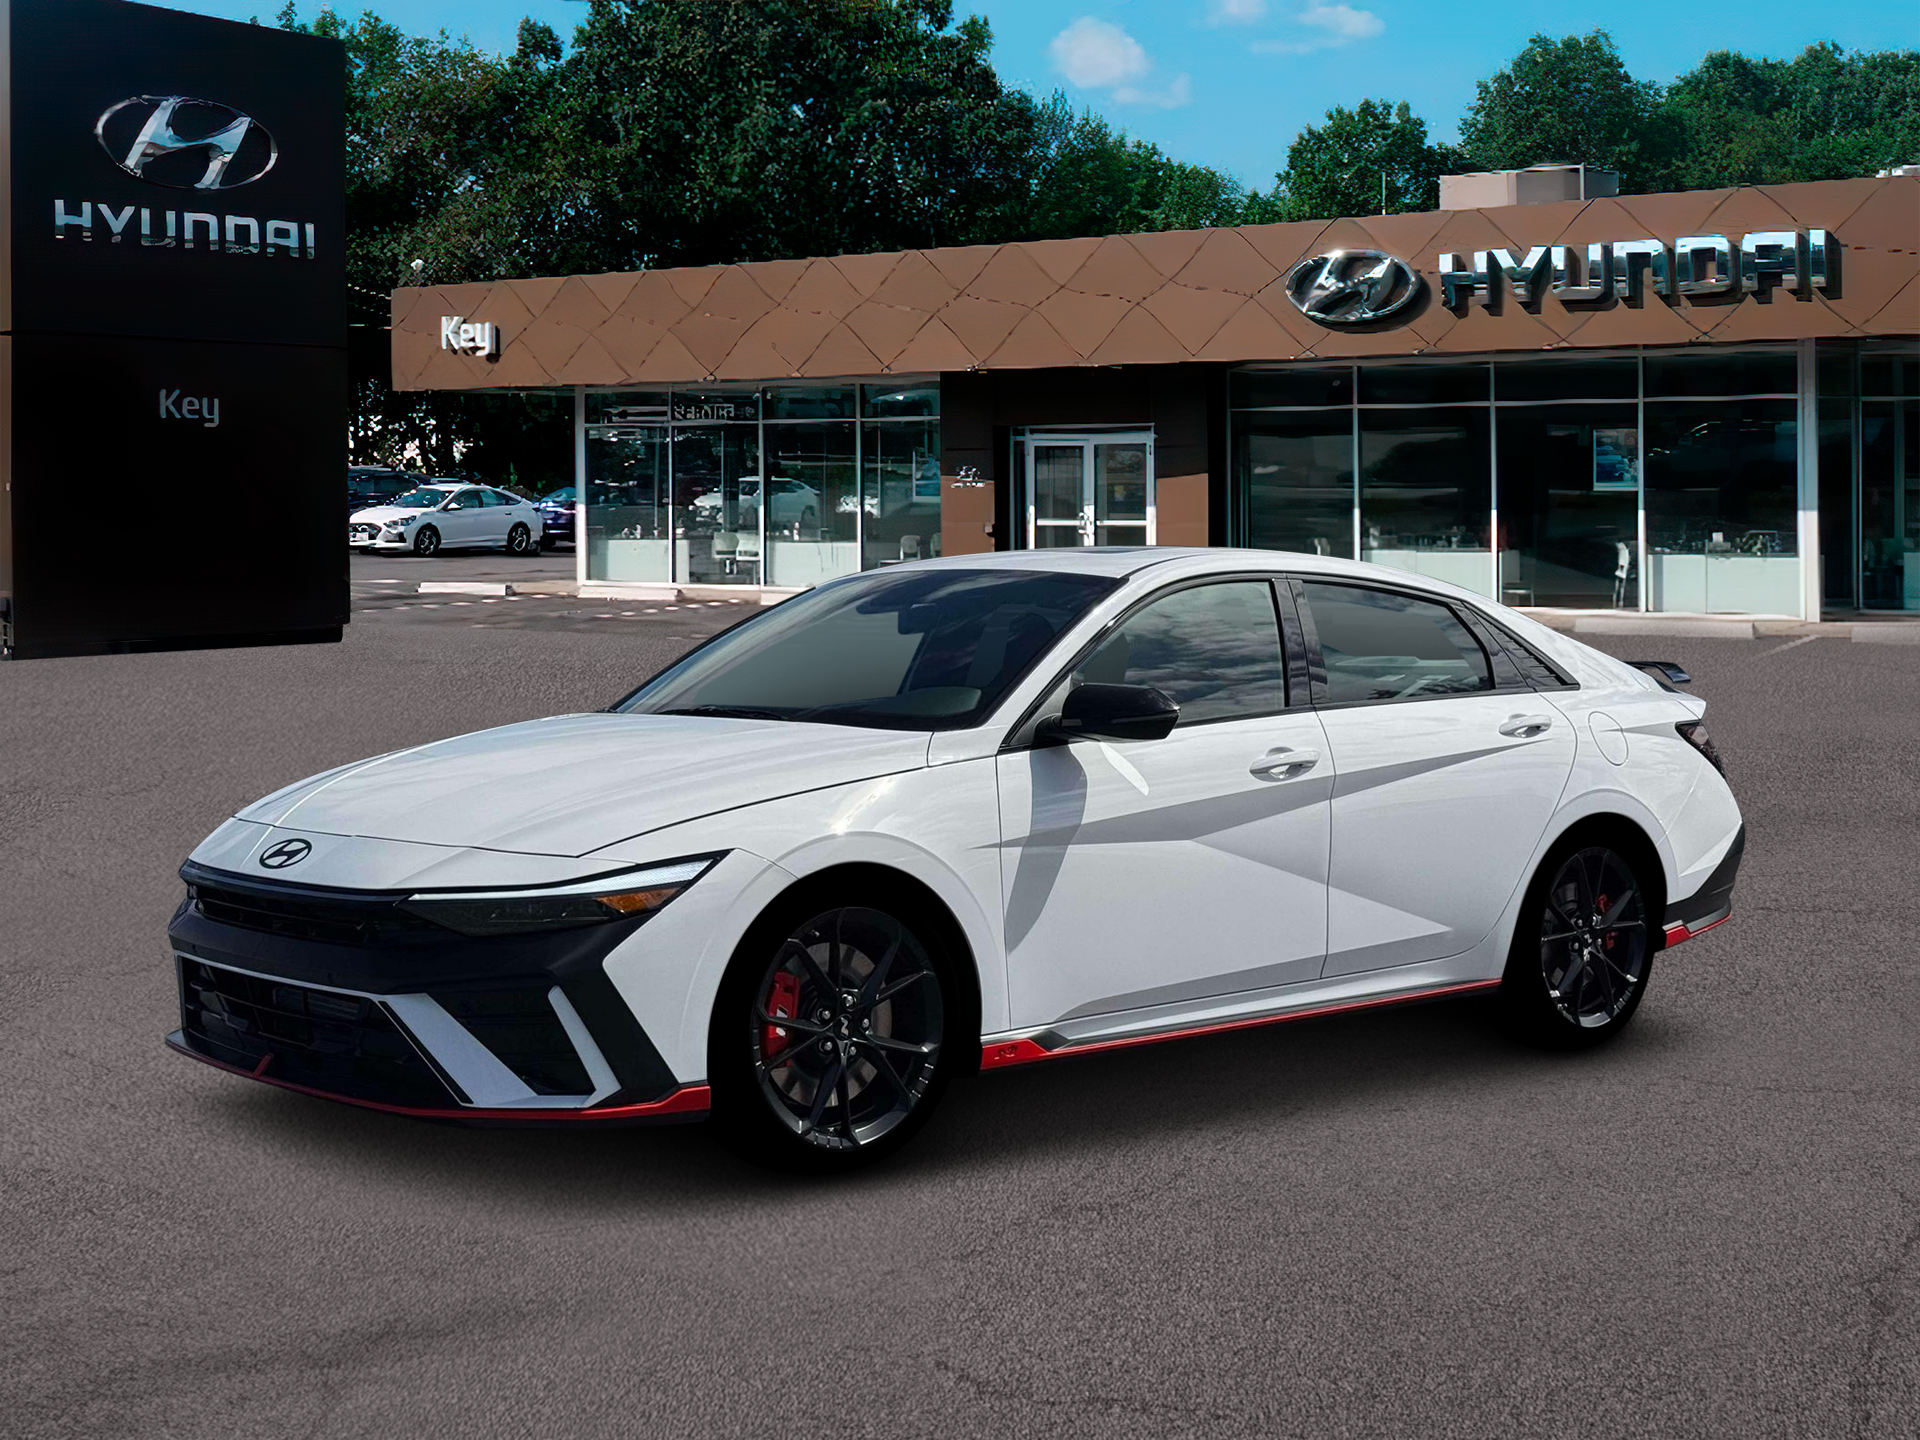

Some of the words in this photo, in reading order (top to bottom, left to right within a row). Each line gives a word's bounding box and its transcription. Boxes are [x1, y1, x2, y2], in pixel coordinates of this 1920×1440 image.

[54, 199, 315, 260] HYUNDAI
[1438, 228, 1837, 310] HYUNDAI
[440, 315, 494, 357] Key
[159, 388, 220, 428] Key
